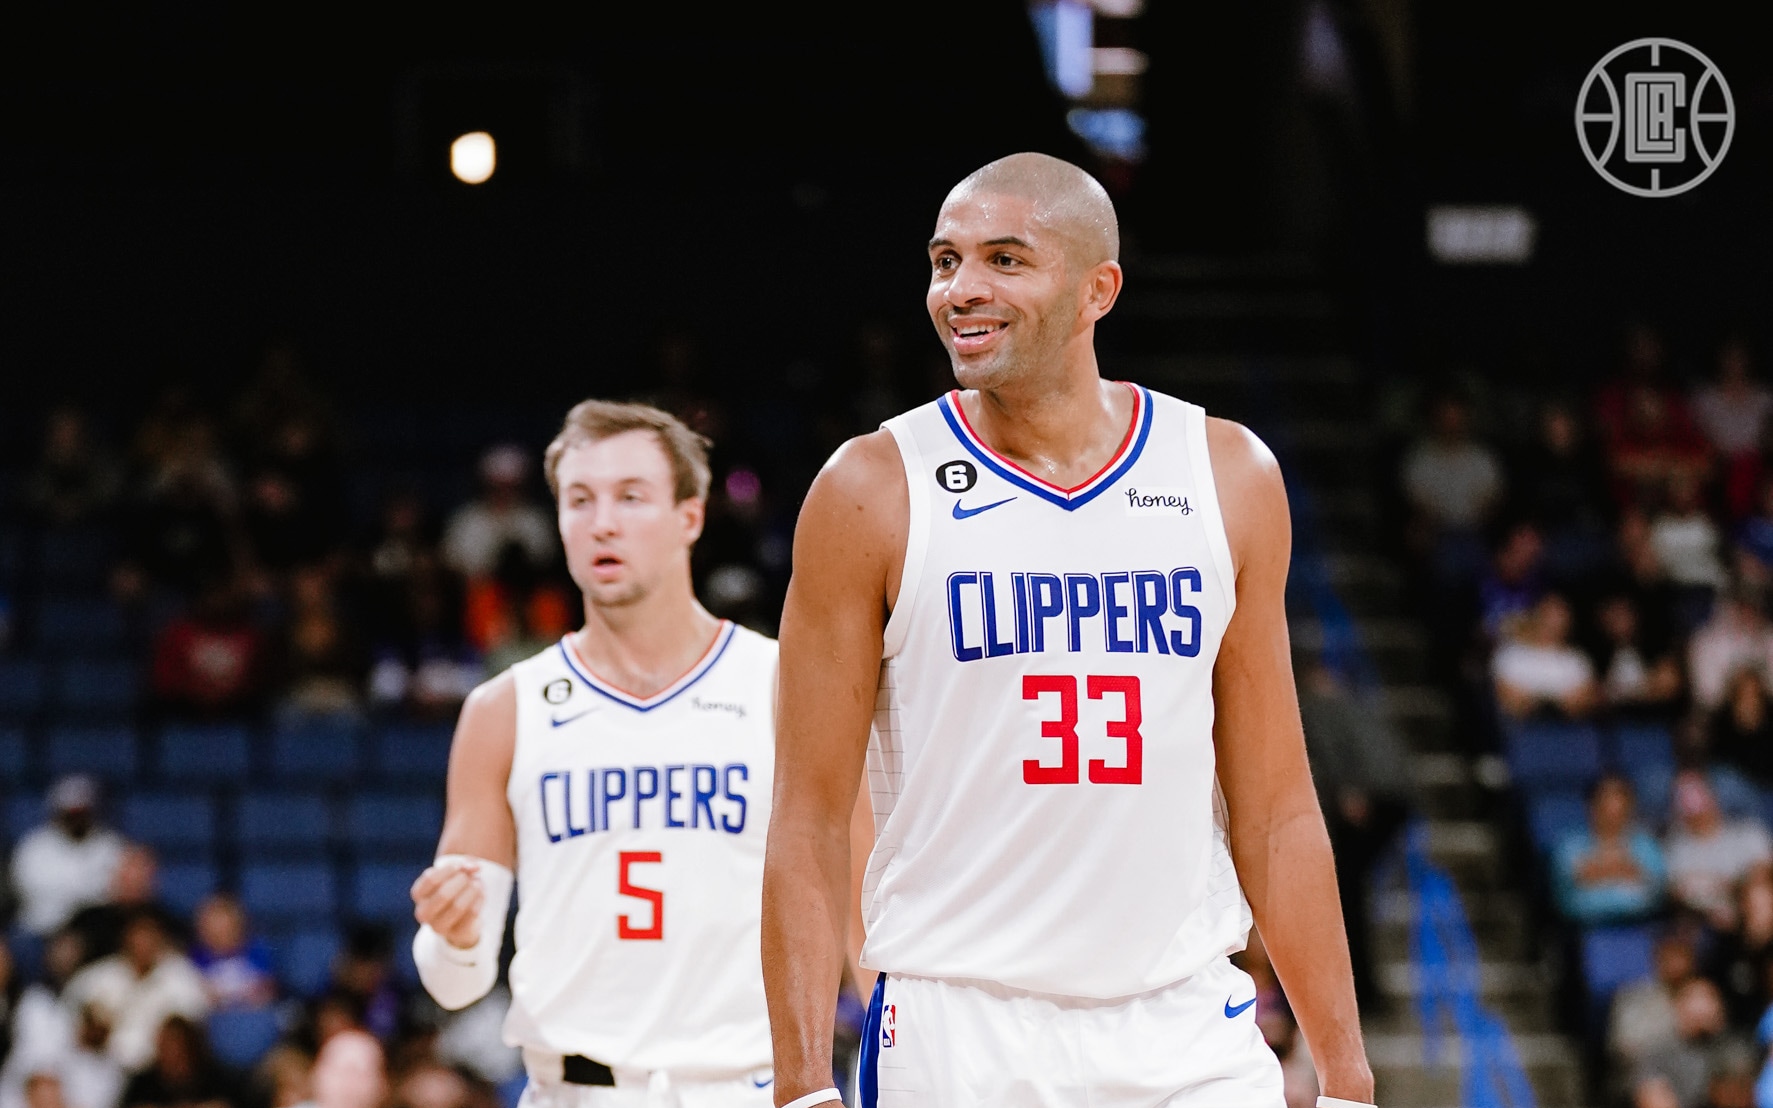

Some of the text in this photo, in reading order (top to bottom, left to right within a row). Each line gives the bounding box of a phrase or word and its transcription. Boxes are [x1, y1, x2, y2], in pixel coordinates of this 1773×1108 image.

[944, 464, 968, 490] 6
[1124, 487, 1194, 516] honey
[946, 567, 1202, 662] CLIPPERS
[1022, 675, 1143, 785] 33
[540, 763, 749, 843] CLIPPERS
[617, 851, 664, 940] 5
